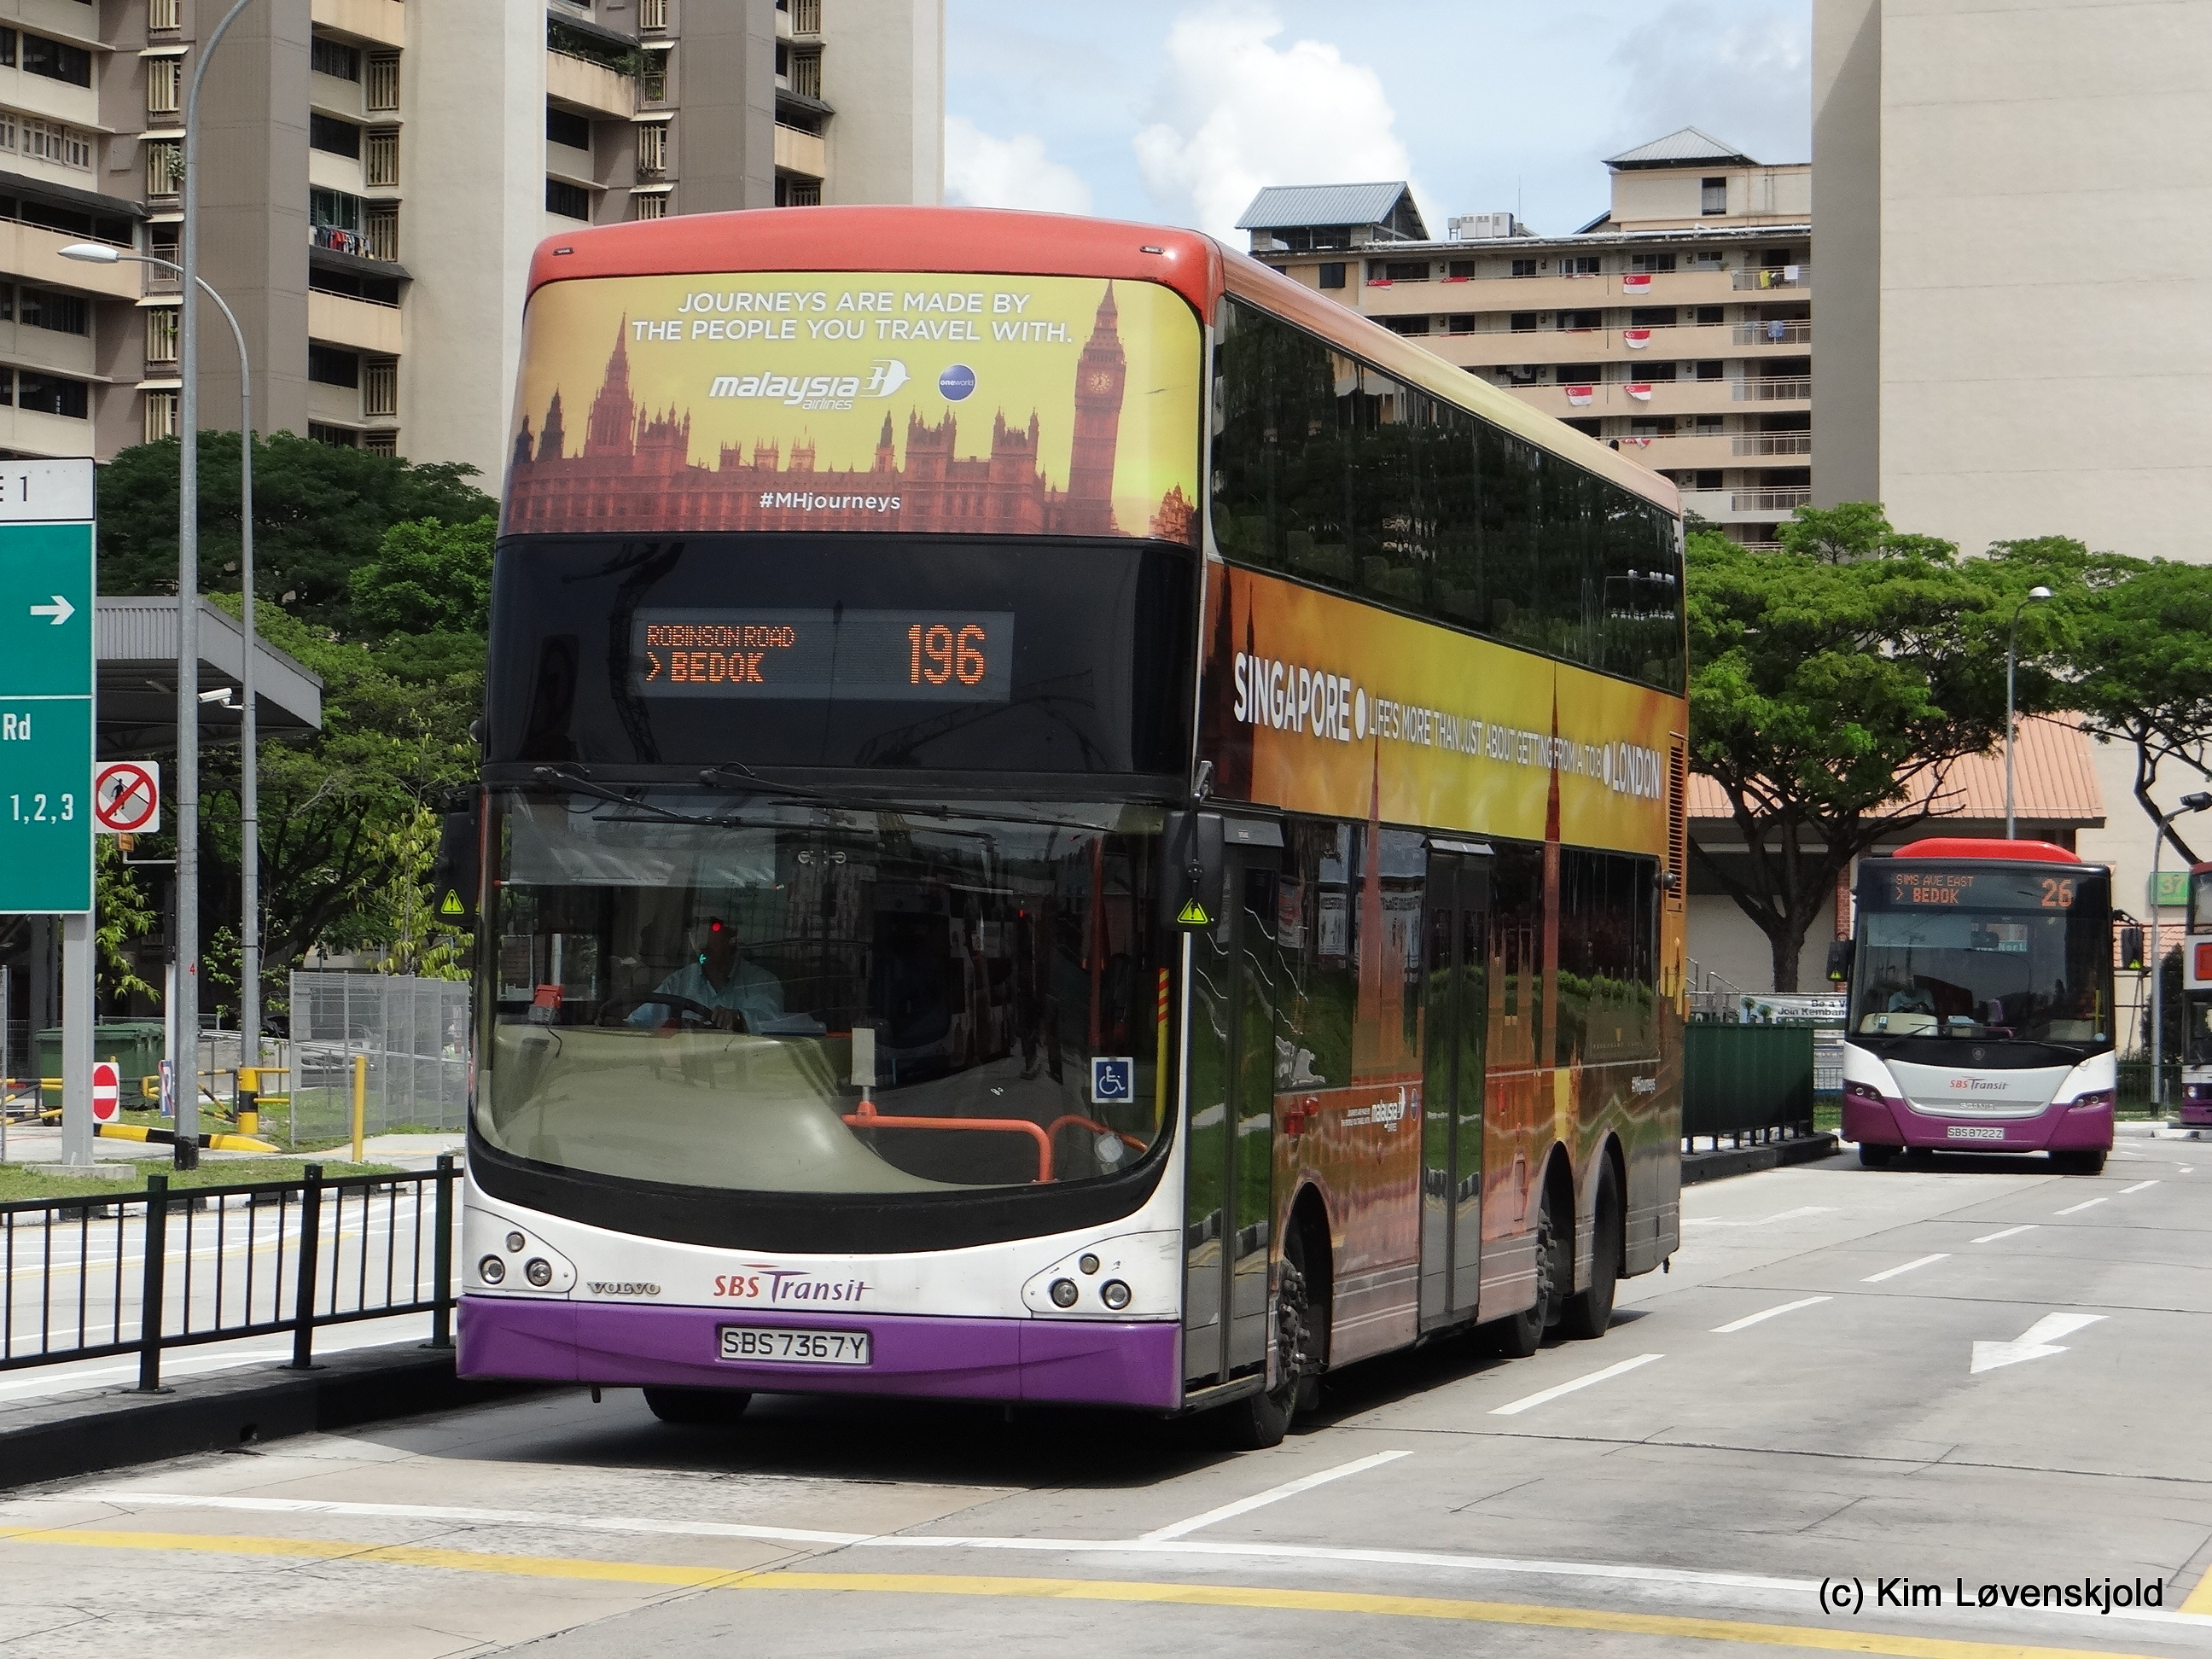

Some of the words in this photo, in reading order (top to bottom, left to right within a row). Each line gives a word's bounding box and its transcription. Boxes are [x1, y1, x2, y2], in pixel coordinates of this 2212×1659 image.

[678, 292, 827, 313] JOURNEYS
[835, 292, 894, 312] ARE
[903, 293, 983, 313] MADE
[992, 294, 1030, 314] BY
[632, 321, 683, 341] THE
[691, 319, 797, 340] PEOPLE
[807, 319, 864, 340] YOU
[875, 319, 981, 341] TRAVEL
[992, 321, 1073, 342] WITH.
[708, 371, 860, 405] malaysia
[802, 399, 853, 410] airlines
[19, 475, 27, 502] 1
[760, 492, 901, 513] #MHjourneys
[647, 625, 741, 647] ROBINSON
[743, 626, 796, 648] ROAD
[908, 624, 985, 684] 196
[671, 651, 765, 683] BEDOK
[1233, 651, 1351, 742] SINGAPORE
[3, 713, 32, 741] Rd
[1369, 696, 1400, 740] LIFE'S
[1401, 704, 1431, 746] MORE
[1434, 711, 1459, 751] THAN
[1460, 718, 1483, 755] JUST
[1484, 724, 1516, 762] ABOUT
[1516, 730, 1553, 769] GETTING
[1553, 737, 1575, 774] FROM
[1576, 743, 1584, 775] A
[1585, 744, 1596, 777] TO
[1612, 740, 1661, 800] LONDON
[9, 793, 74, 824] 1,2,3
[1895, 874, 1919, 887] SIMS
[1923, 876, 1943, 887] AVE
[1947, 876, 1975, 888] EAST
[2040, 878, 2074, 908] 26
[1912, 887, 1960, 905] BEDOK
[1778, 1007, 1799, 1016] Join
[1811, 999, 1825, 1008] Be
[1950, 1080, 1969, 1089] SBS
[1967, 1078, 2010, 1091] Transit
[587, 1281, 661, 1296] VOLVO
[713, 1274, 760, 1298] SBS
[758, 1270, 874, 1303] Transit
